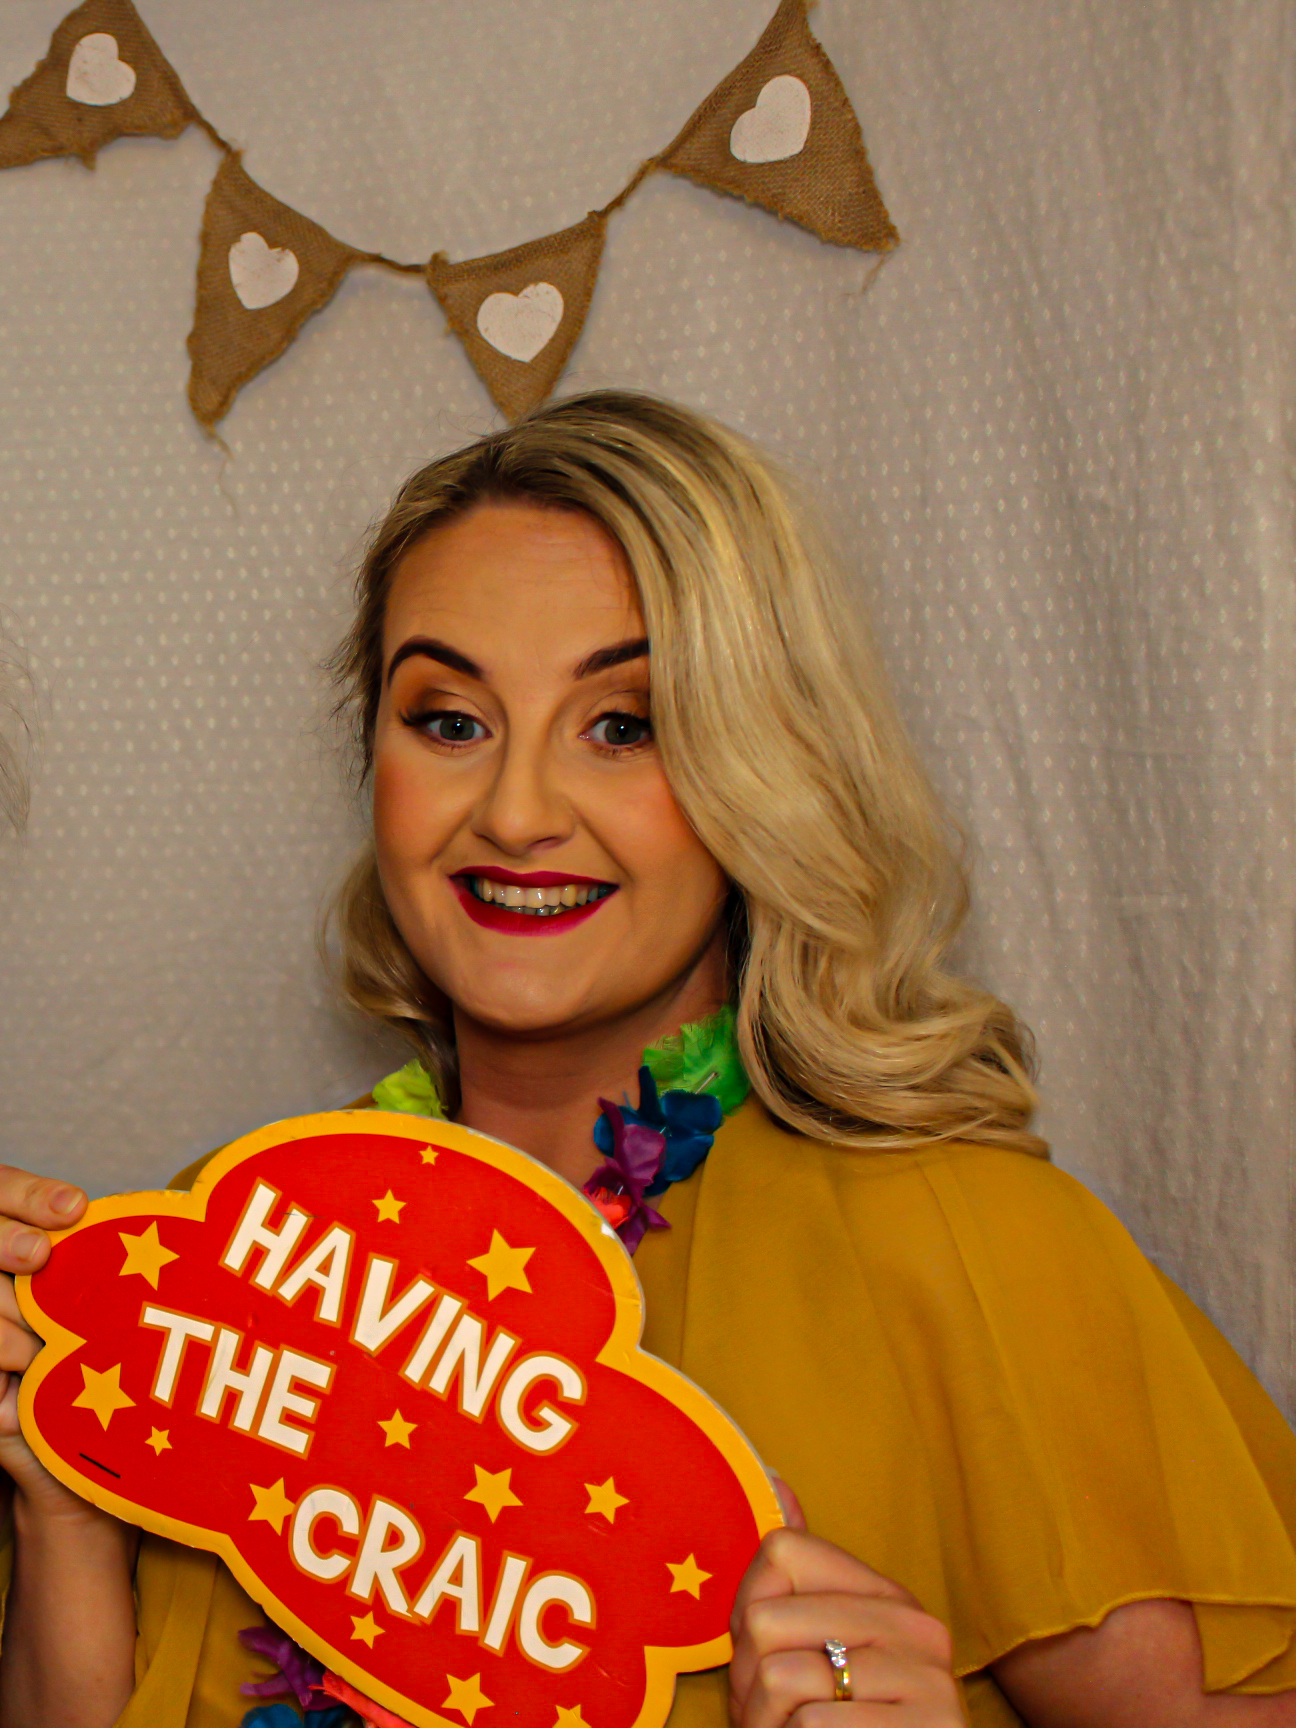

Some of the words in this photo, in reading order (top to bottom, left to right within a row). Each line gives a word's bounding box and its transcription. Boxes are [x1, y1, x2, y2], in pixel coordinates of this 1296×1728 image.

[140, 1303, 334, 1456] THE
[220, 1179, 584, 1454] HAVING
[290, 1486, 596, 1672] CRAIC
